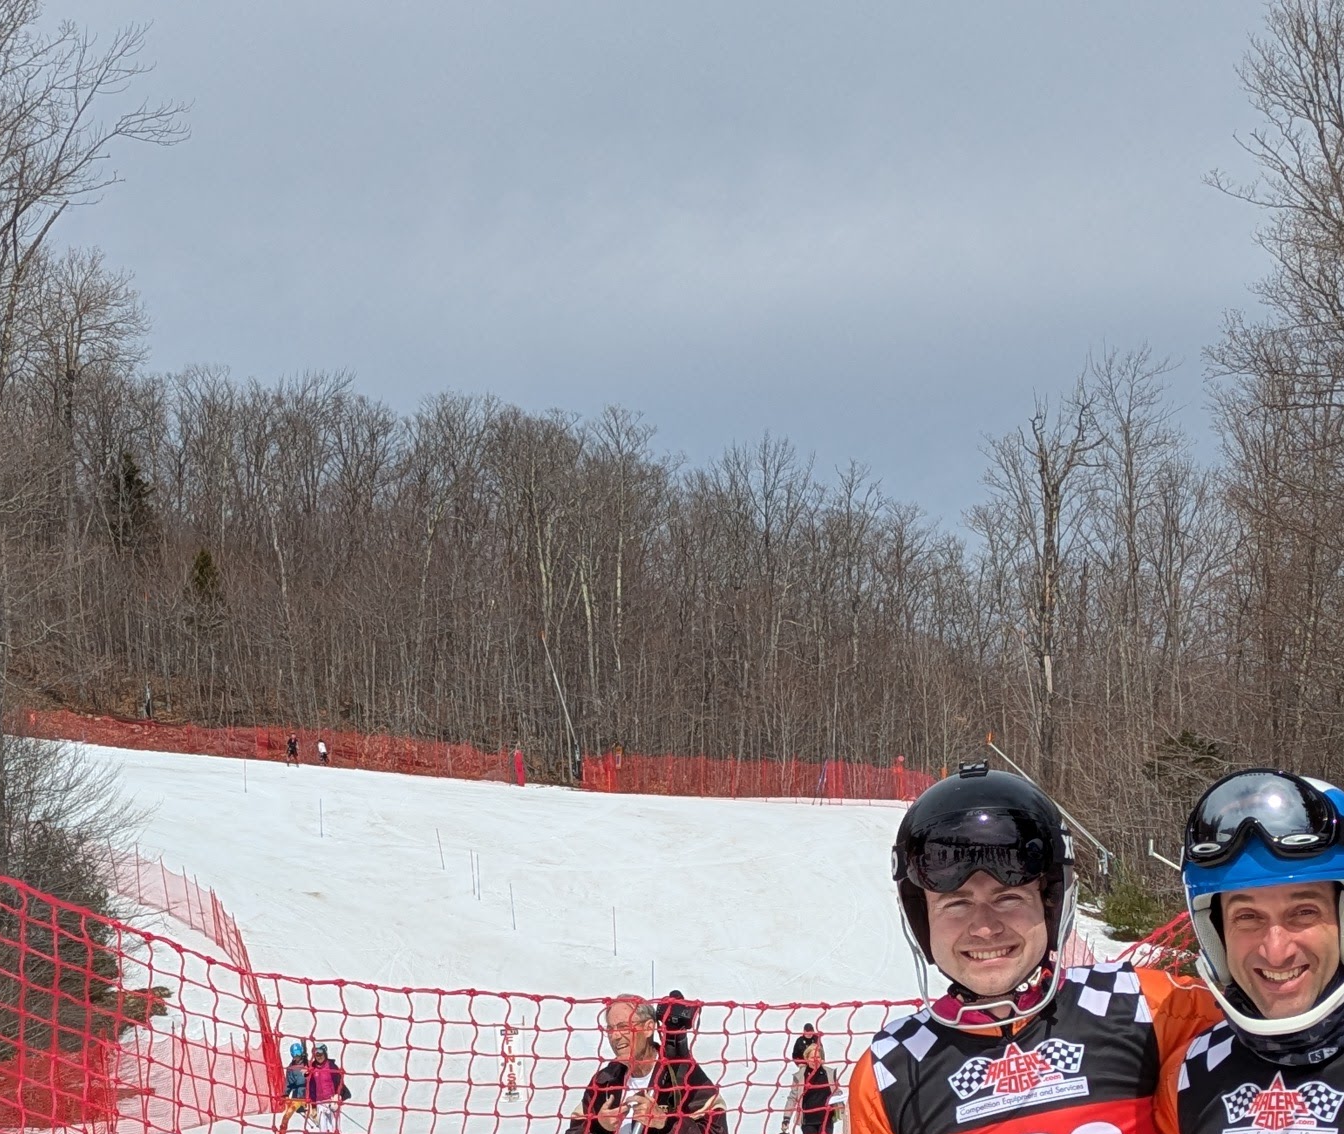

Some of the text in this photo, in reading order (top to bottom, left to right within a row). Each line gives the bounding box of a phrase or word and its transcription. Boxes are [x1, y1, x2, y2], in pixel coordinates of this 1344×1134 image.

[984, 1051, 1052, 1086] RACERS
[996, 1070, 1042, 1093] EDGE
[959, 1083, 1084, 1116] Competition Equipment and Services
[1248, 1092, 1308, 1114] RACERS
[1255, 1111, 1295, 1131] EDGE
